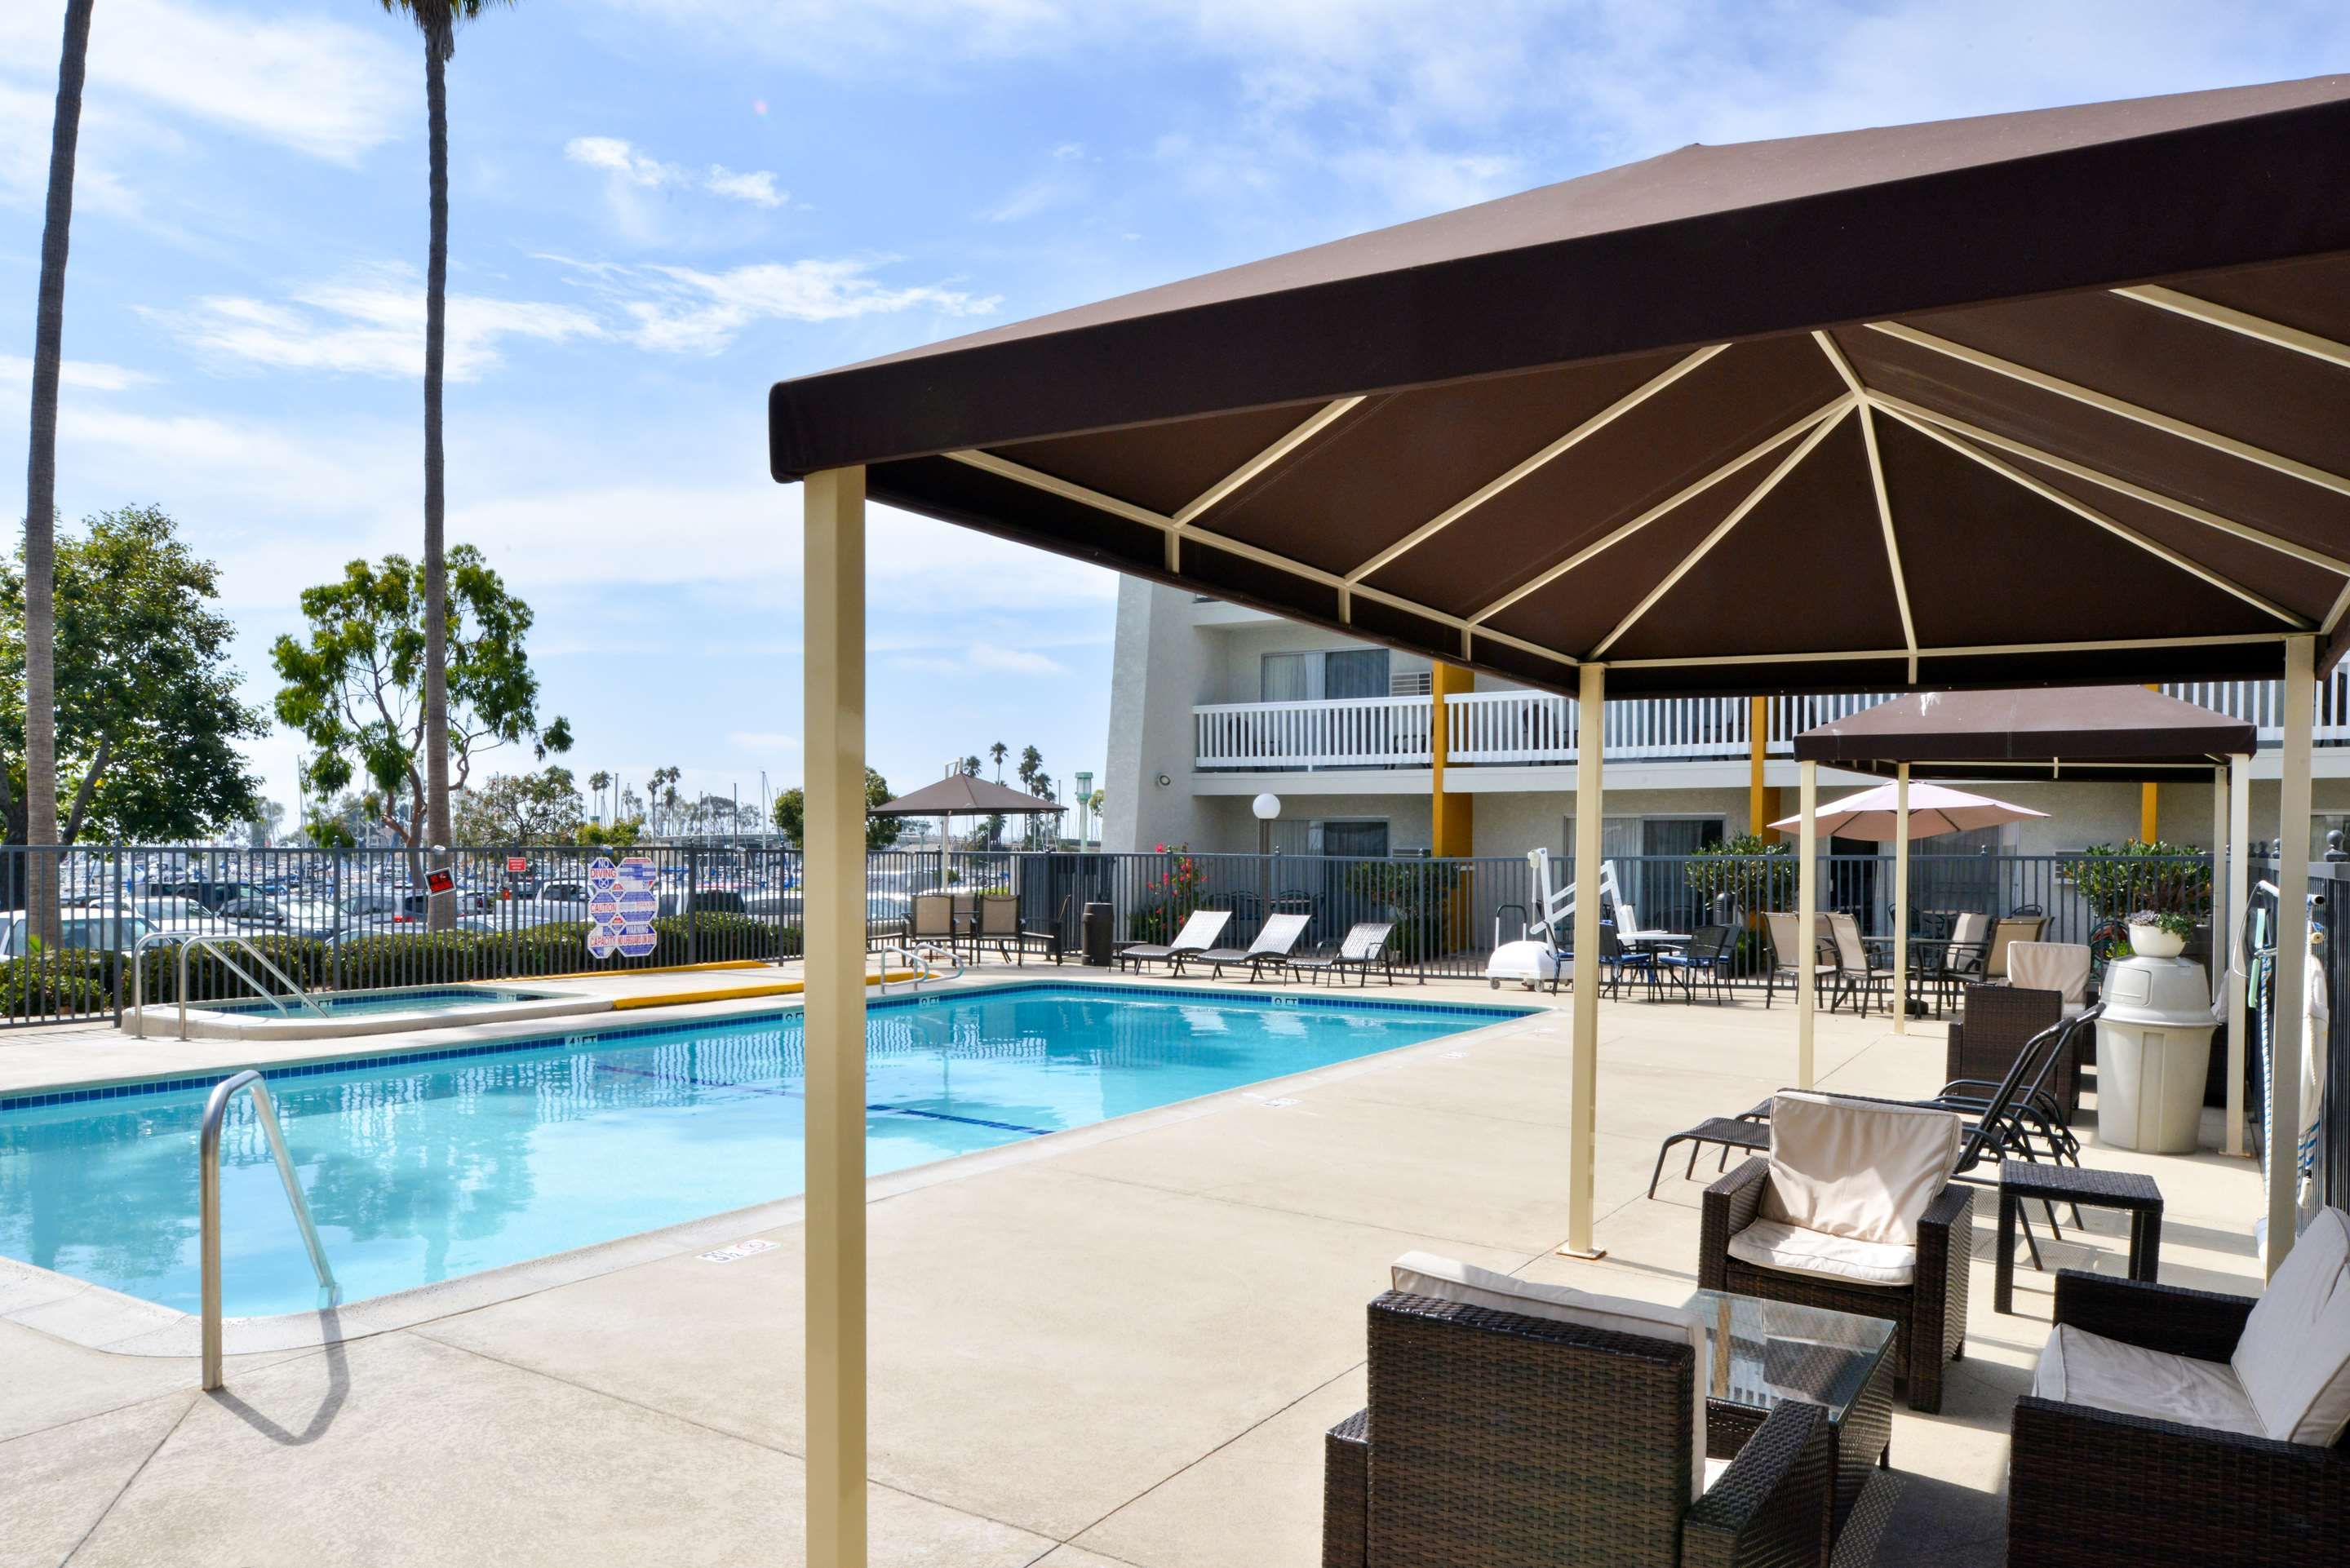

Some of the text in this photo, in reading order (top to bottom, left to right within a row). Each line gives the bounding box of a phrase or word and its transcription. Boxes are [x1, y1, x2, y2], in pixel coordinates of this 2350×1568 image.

[597, 859, 610, 869] NO
[590, 869, 617, 879] DIVING
[590, 902, 617, 912] CAUTION
[626, 925, 649, 934] WARNING
[590, 936, 616, 946] CAPACITY
